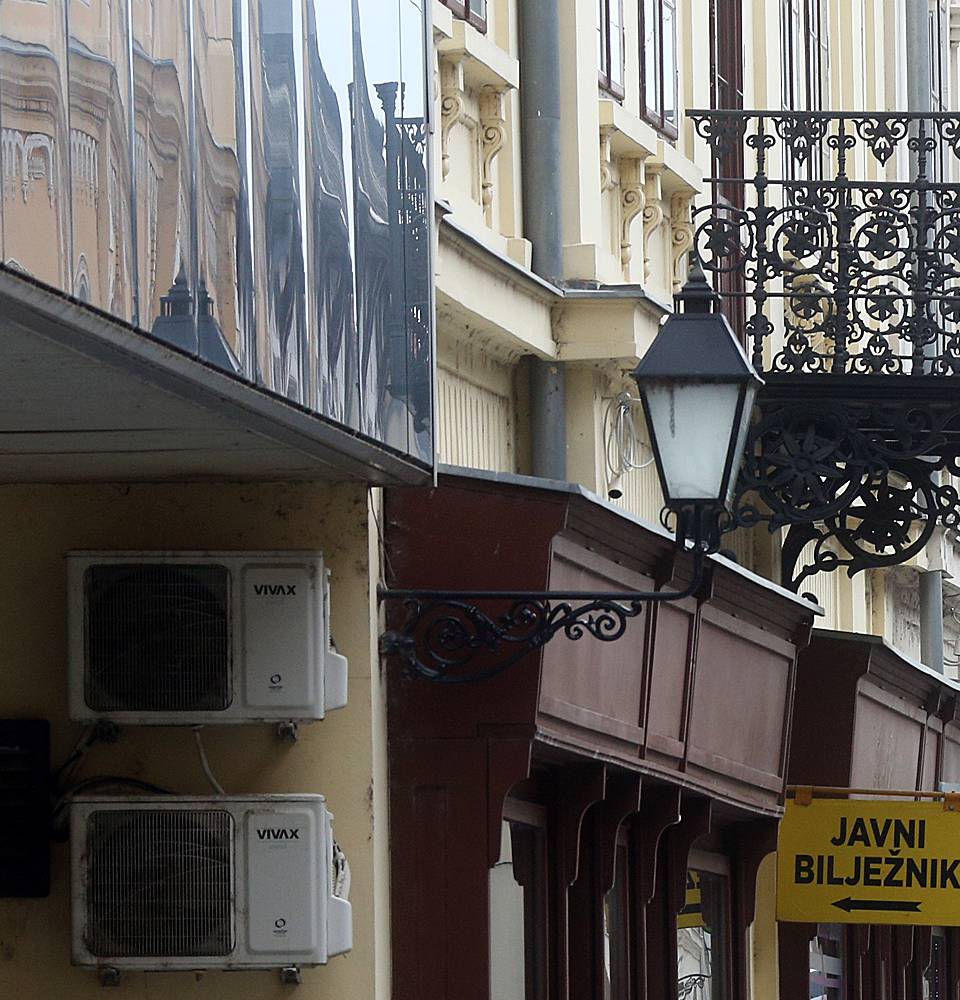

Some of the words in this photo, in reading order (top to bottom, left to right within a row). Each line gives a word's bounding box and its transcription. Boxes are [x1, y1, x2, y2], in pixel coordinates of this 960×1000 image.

[254, 584, 297, 596] VIVAX
[257, 828, 300, 840] VIVAX
[830, 816, 926, 849] JAVNI
